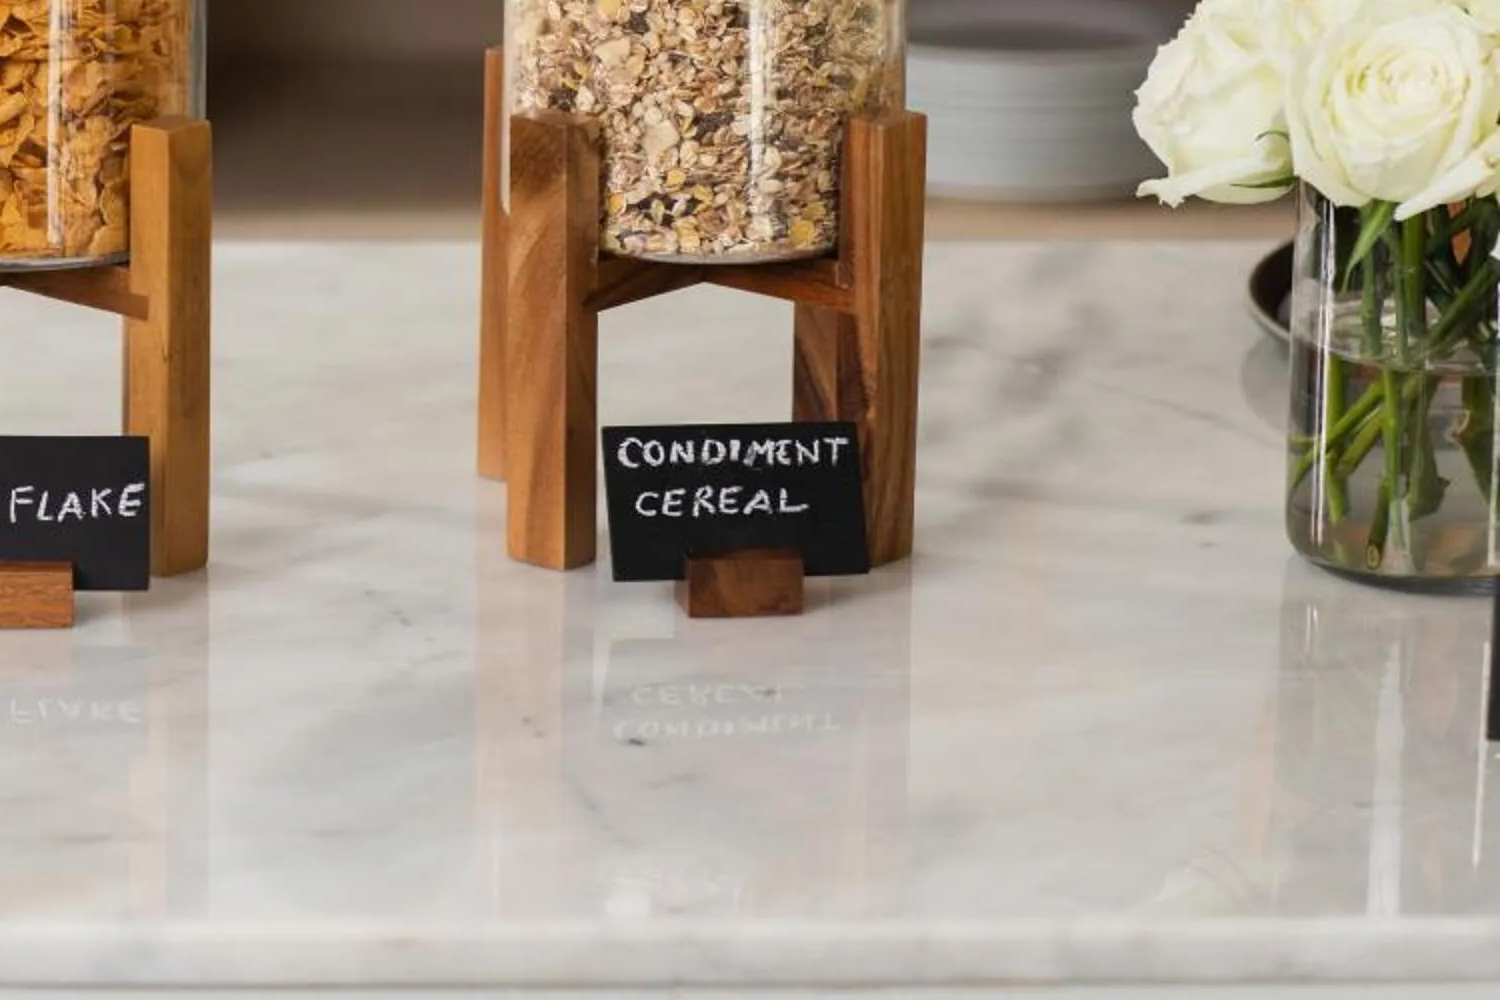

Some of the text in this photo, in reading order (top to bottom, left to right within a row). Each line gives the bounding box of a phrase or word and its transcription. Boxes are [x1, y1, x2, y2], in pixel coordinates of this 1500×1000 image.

[617, 437, 848, 468] CONDIMENT
[10, 483, 145, 523] FLAKE
[635, 486, 808, 517] CEREAL
